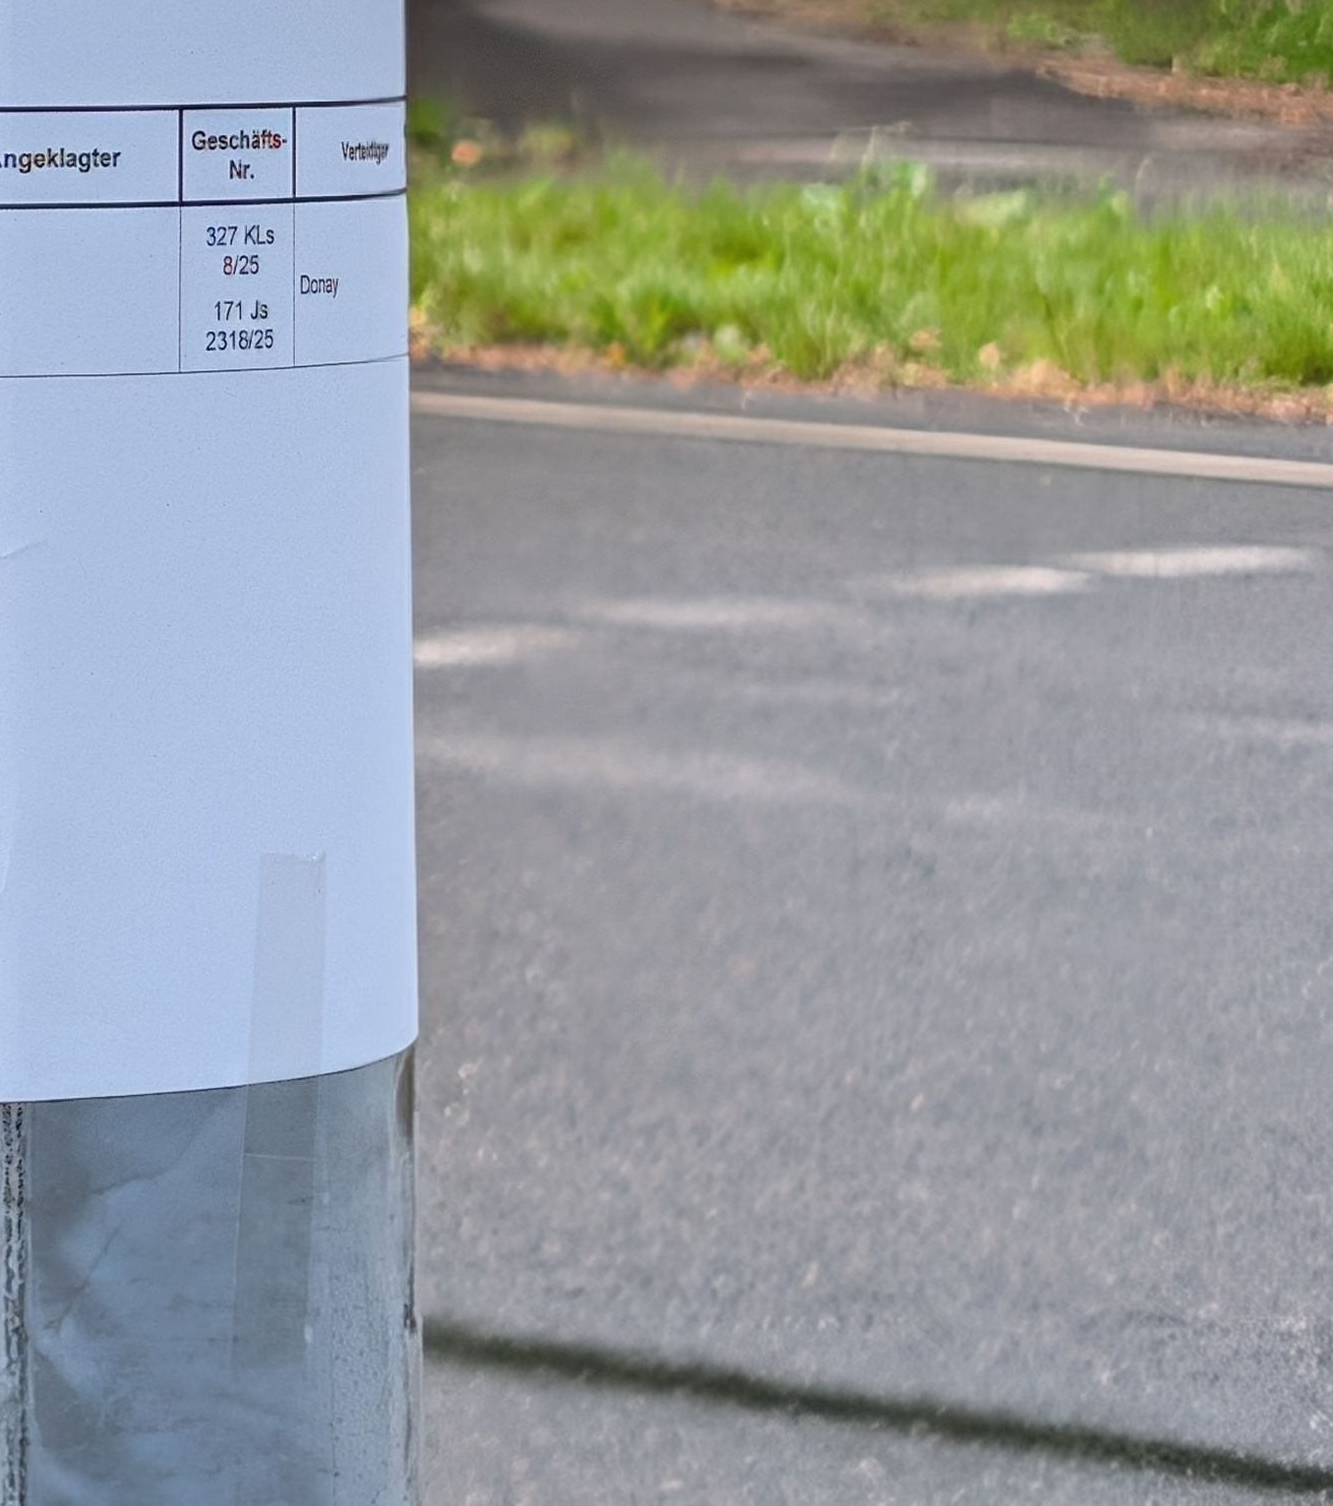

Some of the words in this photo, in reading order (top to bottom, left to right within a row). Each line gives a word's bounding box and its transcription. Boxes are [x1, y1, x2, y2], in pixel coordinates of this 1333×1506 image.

[191, 130, 288, 152] Geschäfts-
[229, 161, 255, 180] Nr.
[206, 226, 237, 246] 327
[244, 224, 275, 245] KLs
[223, 255, 259, 276] 8/25
[300, 275, 339, 299] Donay
[214, 301, 243, 321] 171
[251, 299, 268, 320] Js
[206, 329, 274, 352] 2318/25
